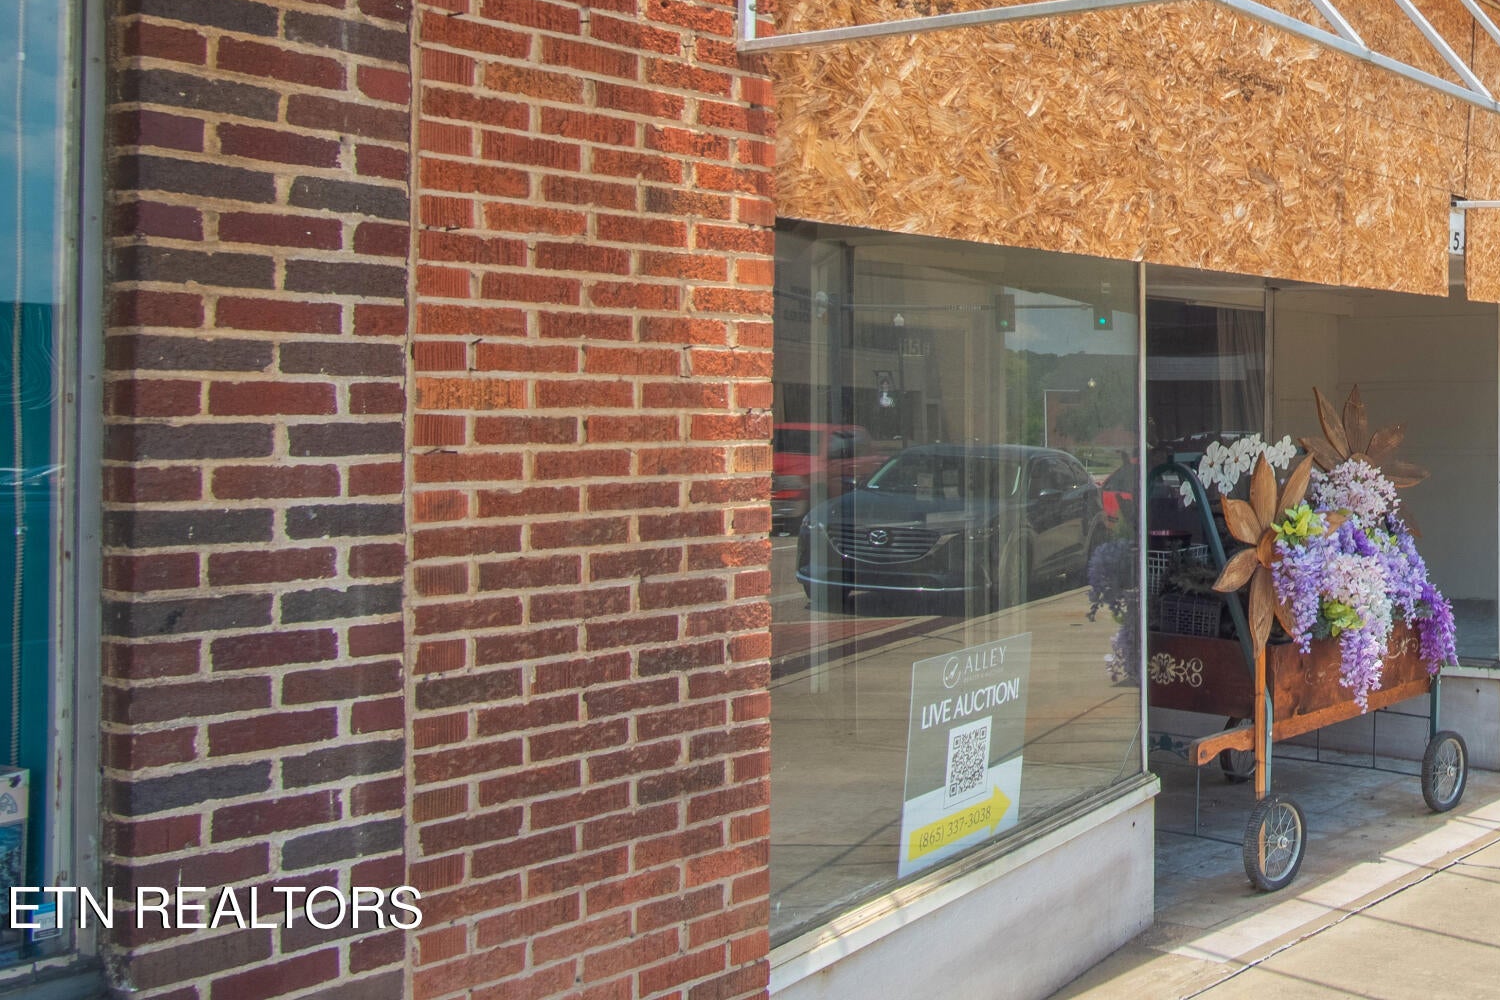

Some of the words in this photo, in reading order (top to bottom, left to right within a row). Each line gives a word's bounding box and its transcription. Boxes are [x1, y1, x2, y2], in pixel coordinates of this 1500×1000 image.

[1453, 231, 1460, 251] 5
[965, 646, 1007, 675] ALLEY
[921, 698, 952, 729] LIVE
[953, 677, 1020, 719] AUCTION!
[920, 824, 945, 851] (865)
[947, 805, 991, 837] 337-3038
